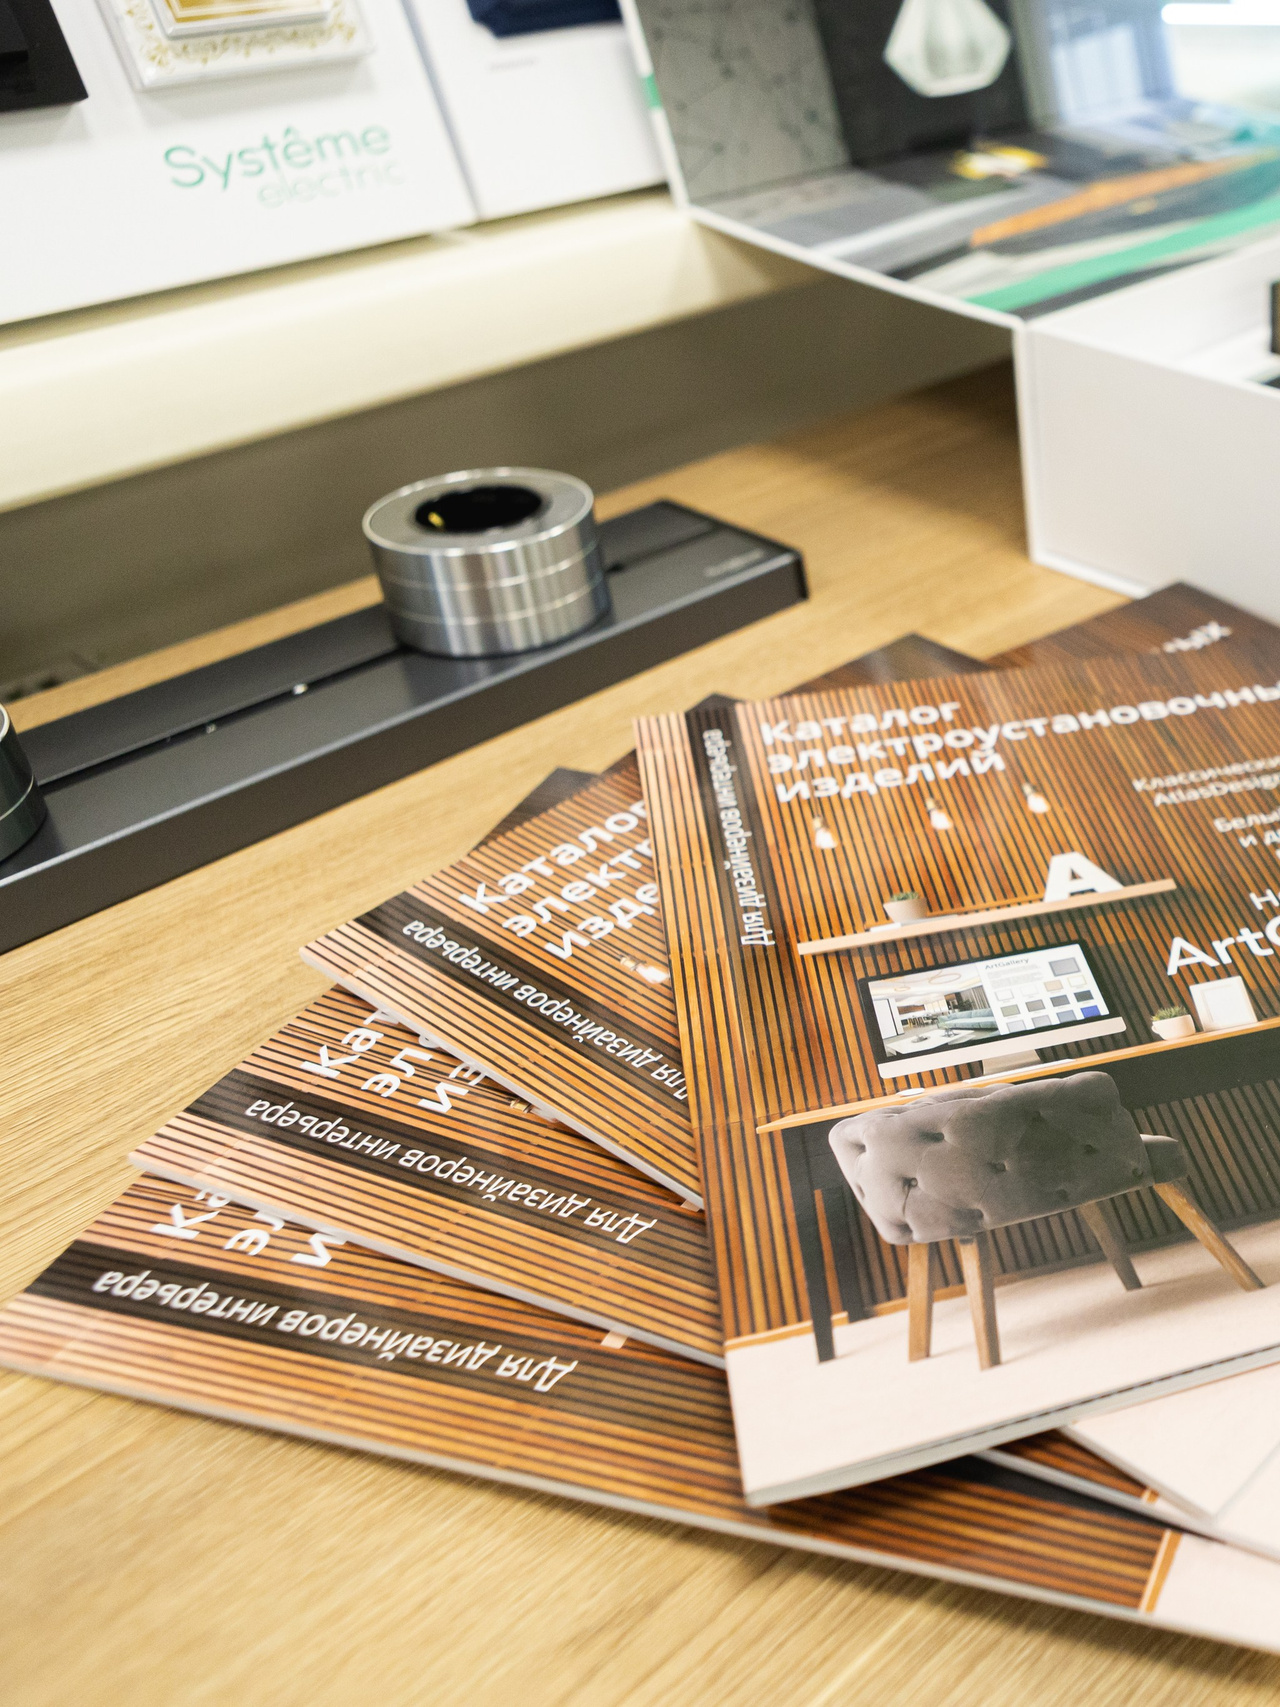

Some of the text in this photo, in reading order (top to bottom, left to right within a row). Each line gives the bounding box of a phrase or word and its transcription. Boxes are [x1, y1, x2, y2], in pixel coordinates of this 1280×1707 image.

[163, 124, 391, 191] Systême
[256, 160, 405, 208] electric
[760, 701, 961, 746] Каталог
[776, 749, 1006, 803] изделий
[702, 728, 776, 946] Для дизайнеров интерьера
[1239, 834, 1258, 848] и
[402, 919, 521, 991] интерьера
[513, 976, 664, 1069] дизайнеров
[244, 1099, 658, 1245] Для дизайнеров интерьера
[91, 1269, 579, 1393] Для дизайнеров интерьера
